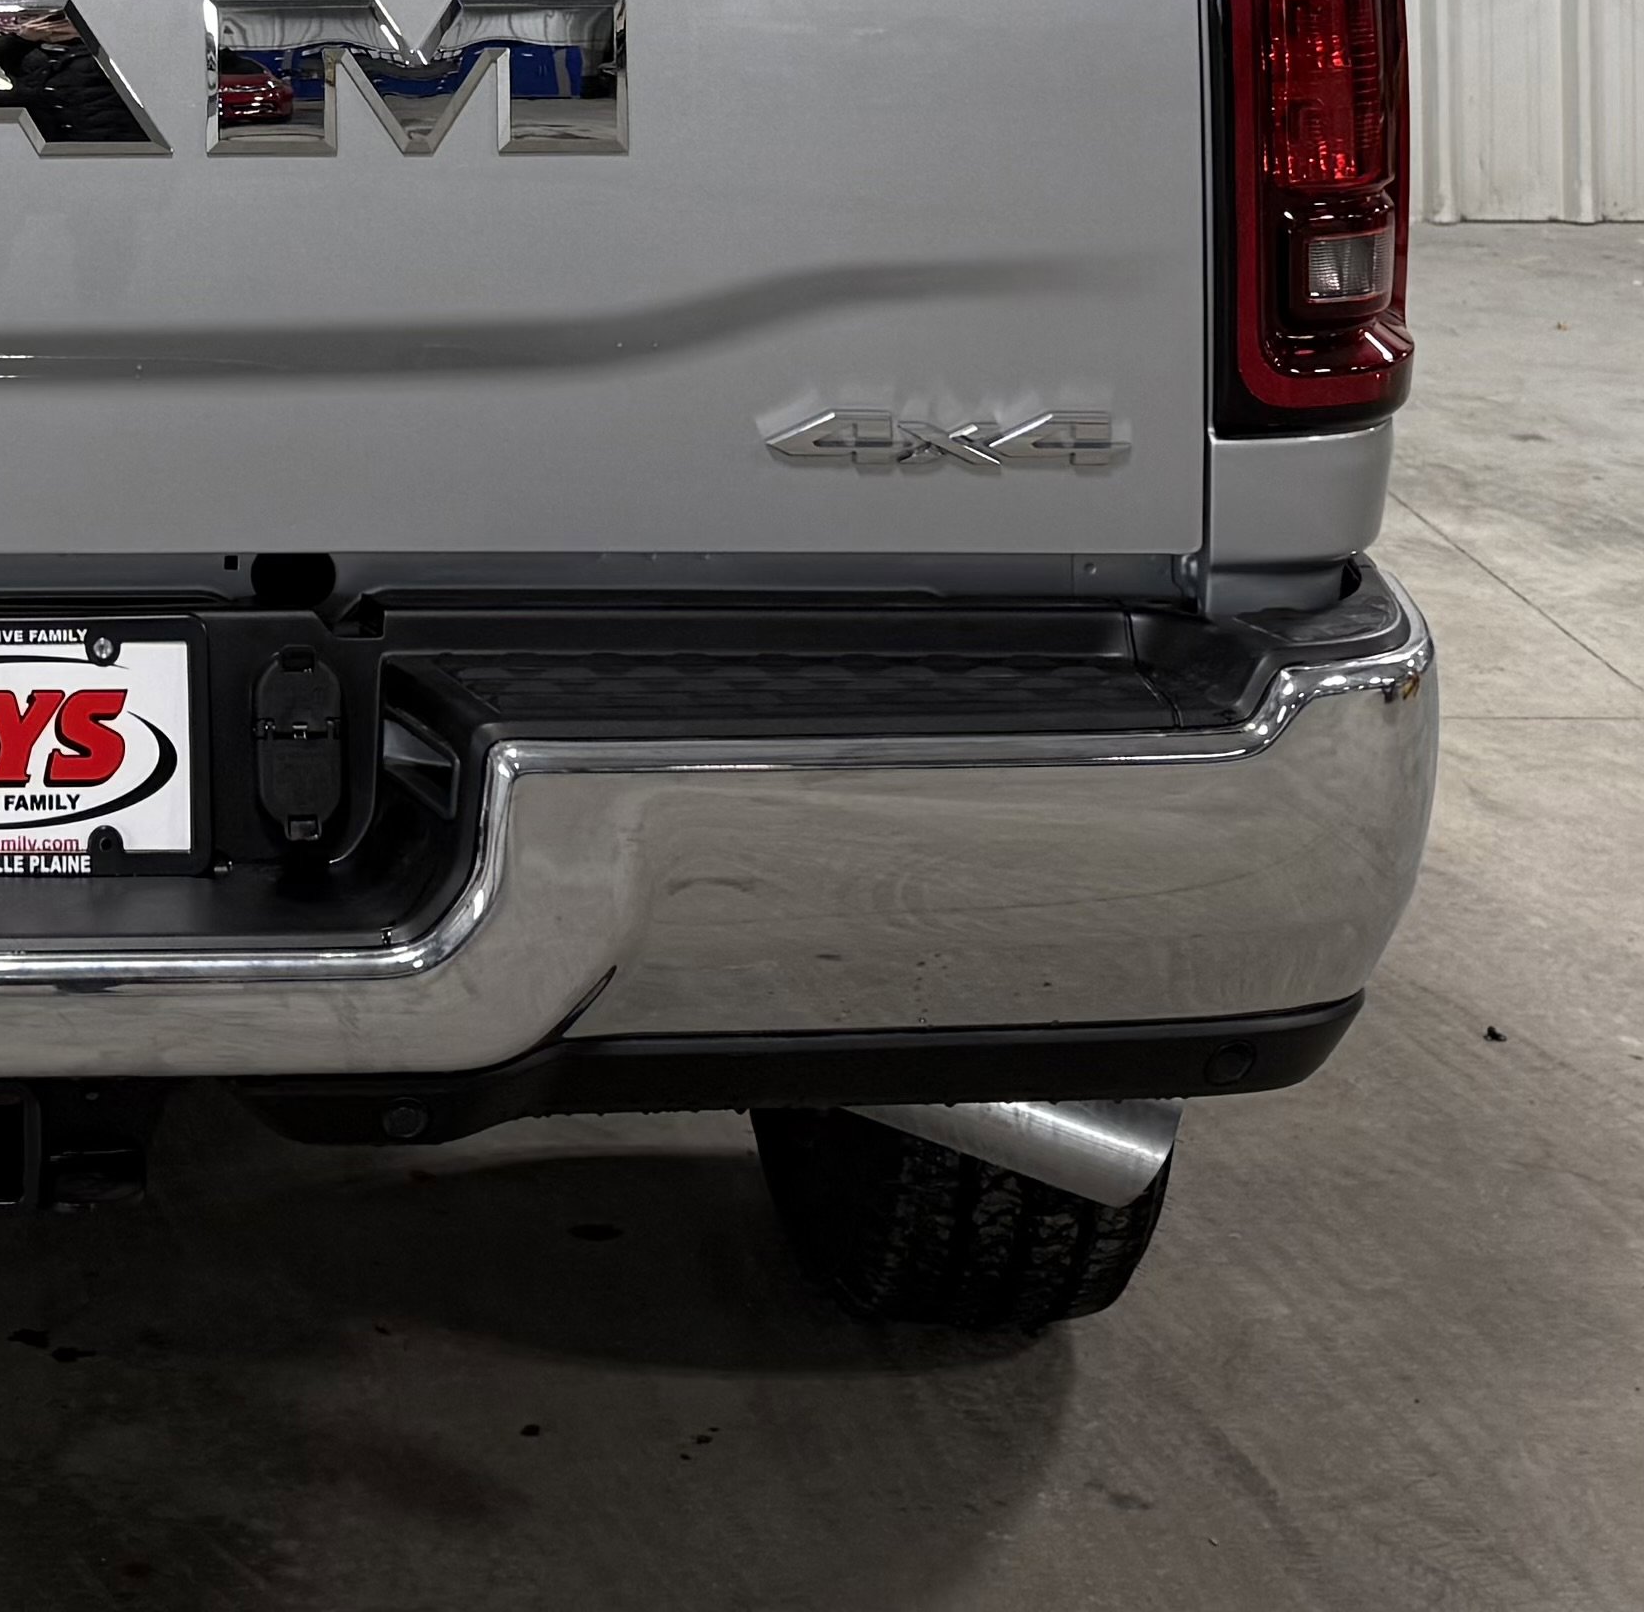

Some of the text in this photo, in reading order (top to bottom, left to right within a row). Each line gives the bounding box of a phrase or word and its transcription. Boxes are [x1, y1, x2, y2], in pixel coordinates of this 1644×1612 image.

[29, 628, 88, 642] FAMILY
[3, 793, 80, 812] FAMILY
[30, 855, 91, 873] PLAINE
